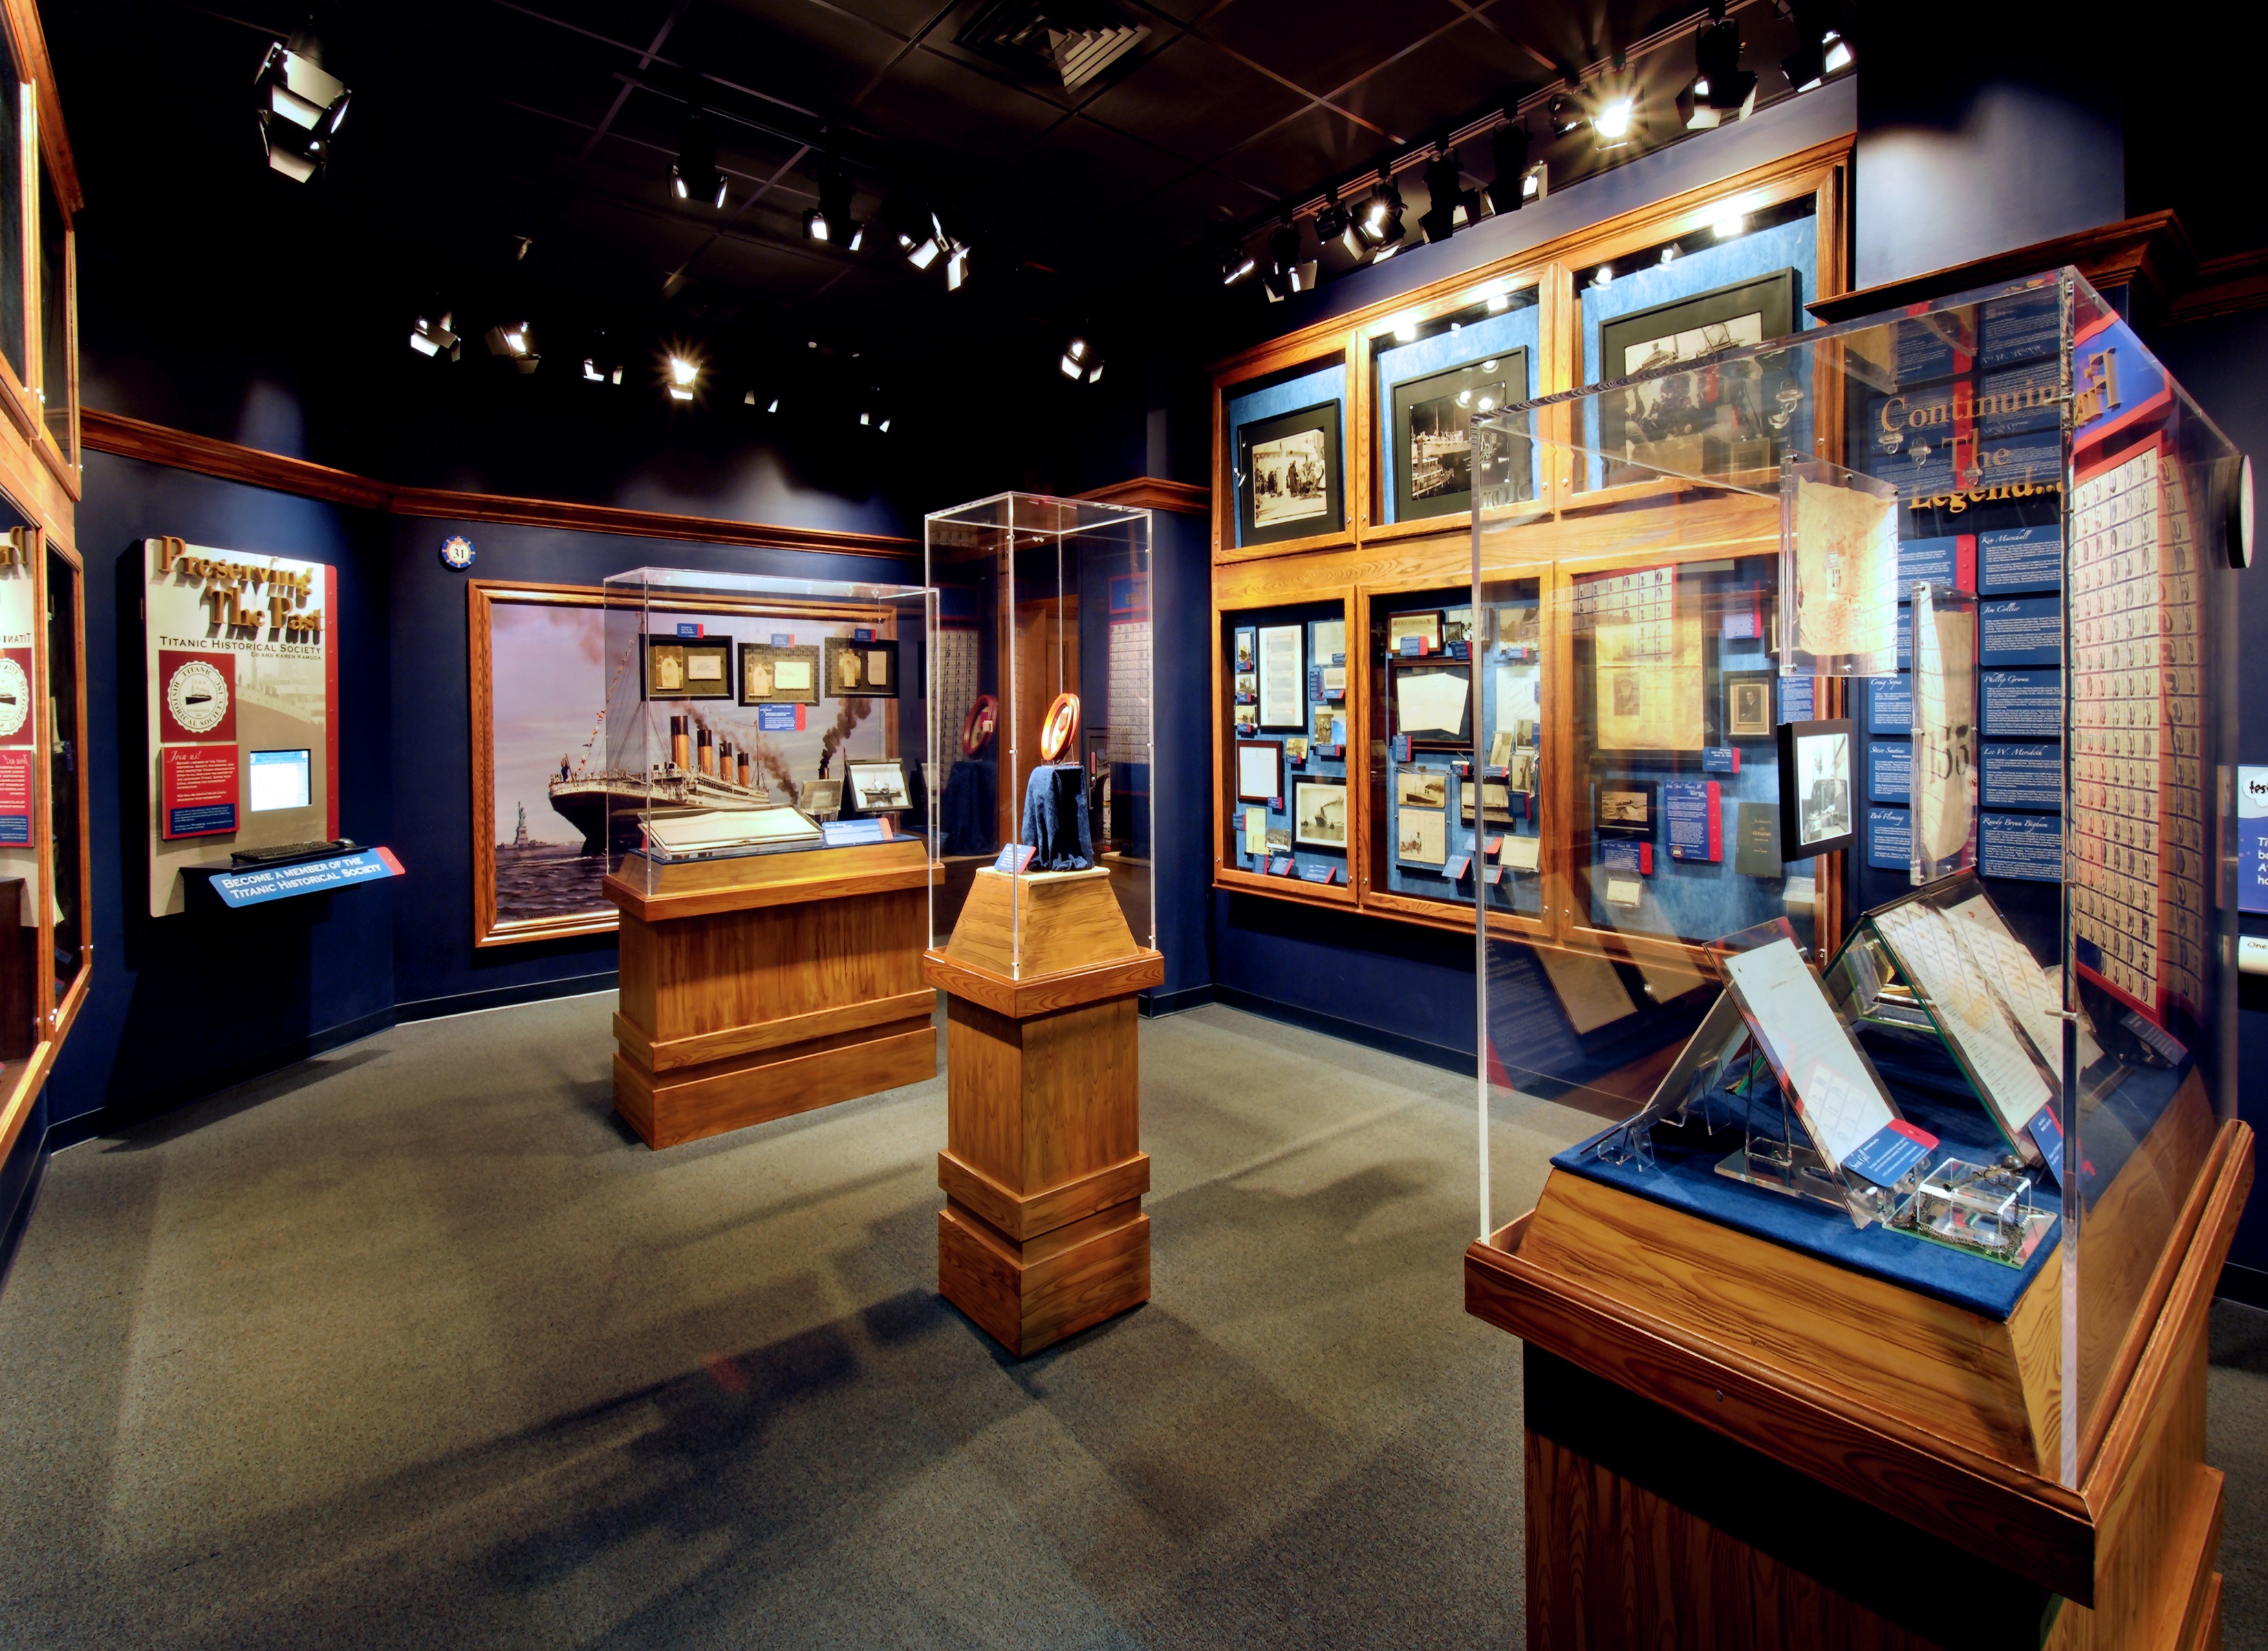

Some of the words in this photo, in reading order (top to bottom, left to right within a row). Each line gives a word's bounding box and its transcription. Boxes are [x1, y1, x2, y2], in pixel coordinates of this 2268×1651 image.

[1881, 378, 2060, 432] Continuin
[1941, 428, 2011, 473] The
[453, 548, 464, 559] 31
[1981, 536, 1994, 544] Ken
[158, 535, 314, 597] Preserving
[208, 585, 266, 627] The
[269, 596, 326, 632] Past
[160, 636, 208, 648] TITANIC
[212, 639, 277, 651] HISTORICAL
[280, 644, 321, 654] SOCIETY
[182, 667, 211, 676] TITANIC
[173, 682, 196, 726] HISTORICAL
[222, 872, 274, 889] BECOME
[275, 870, 284, 878] A
[283, 863, 327, 878] MEMBER
[329, 861, 341, 870] OF
[341, 857, 363, 866] THE
[230, 883, 277, 899] TITANIC
[277, 873, 341, 890] HISTORICAL
[341, 864, 381, 878] SOCIETY
